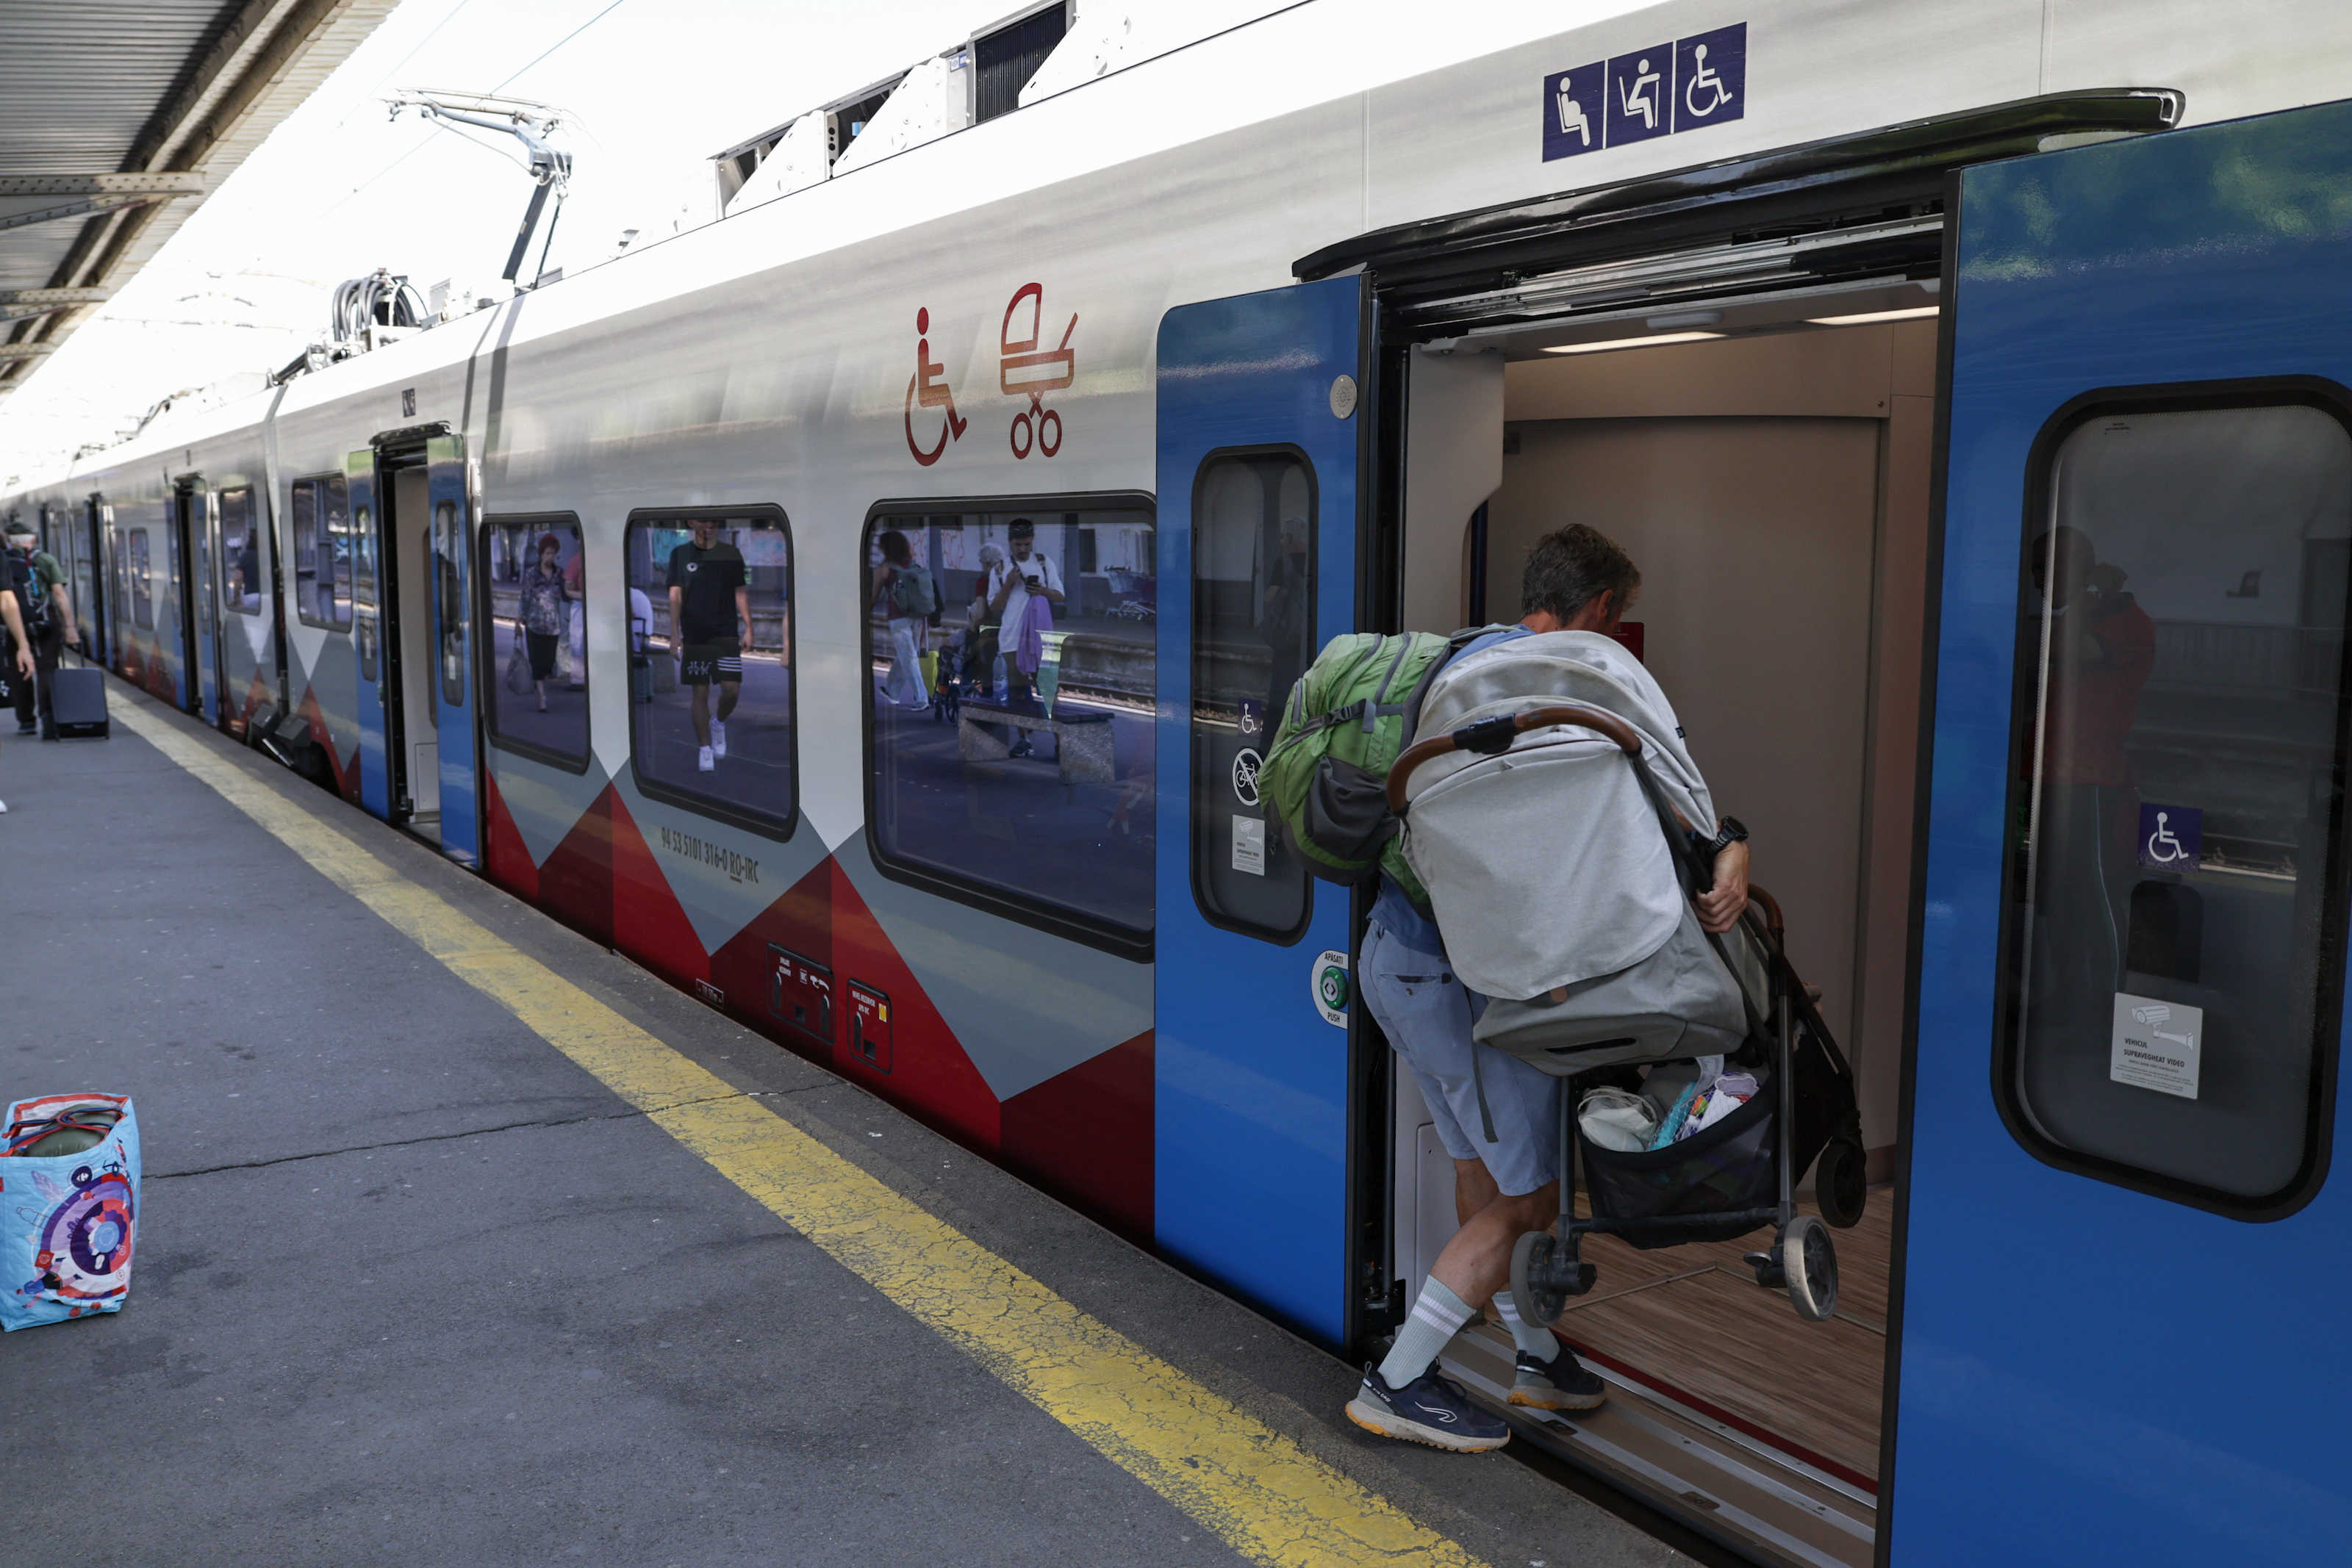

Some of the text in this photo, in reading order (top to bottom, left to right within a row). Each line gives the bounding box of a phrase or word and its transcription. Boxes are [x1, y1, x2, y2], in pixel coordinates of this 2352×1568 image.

[662, 827, 759, 884] 94 53 5101 316-0 RO-IRC
[1327, 1012, 1340, 1023] PUSH
[2124, 1037, 2148, 1049] VEHICUL
[2123, 1049, 2184, 1068] SUPRAVEGHEAT VIDEO
